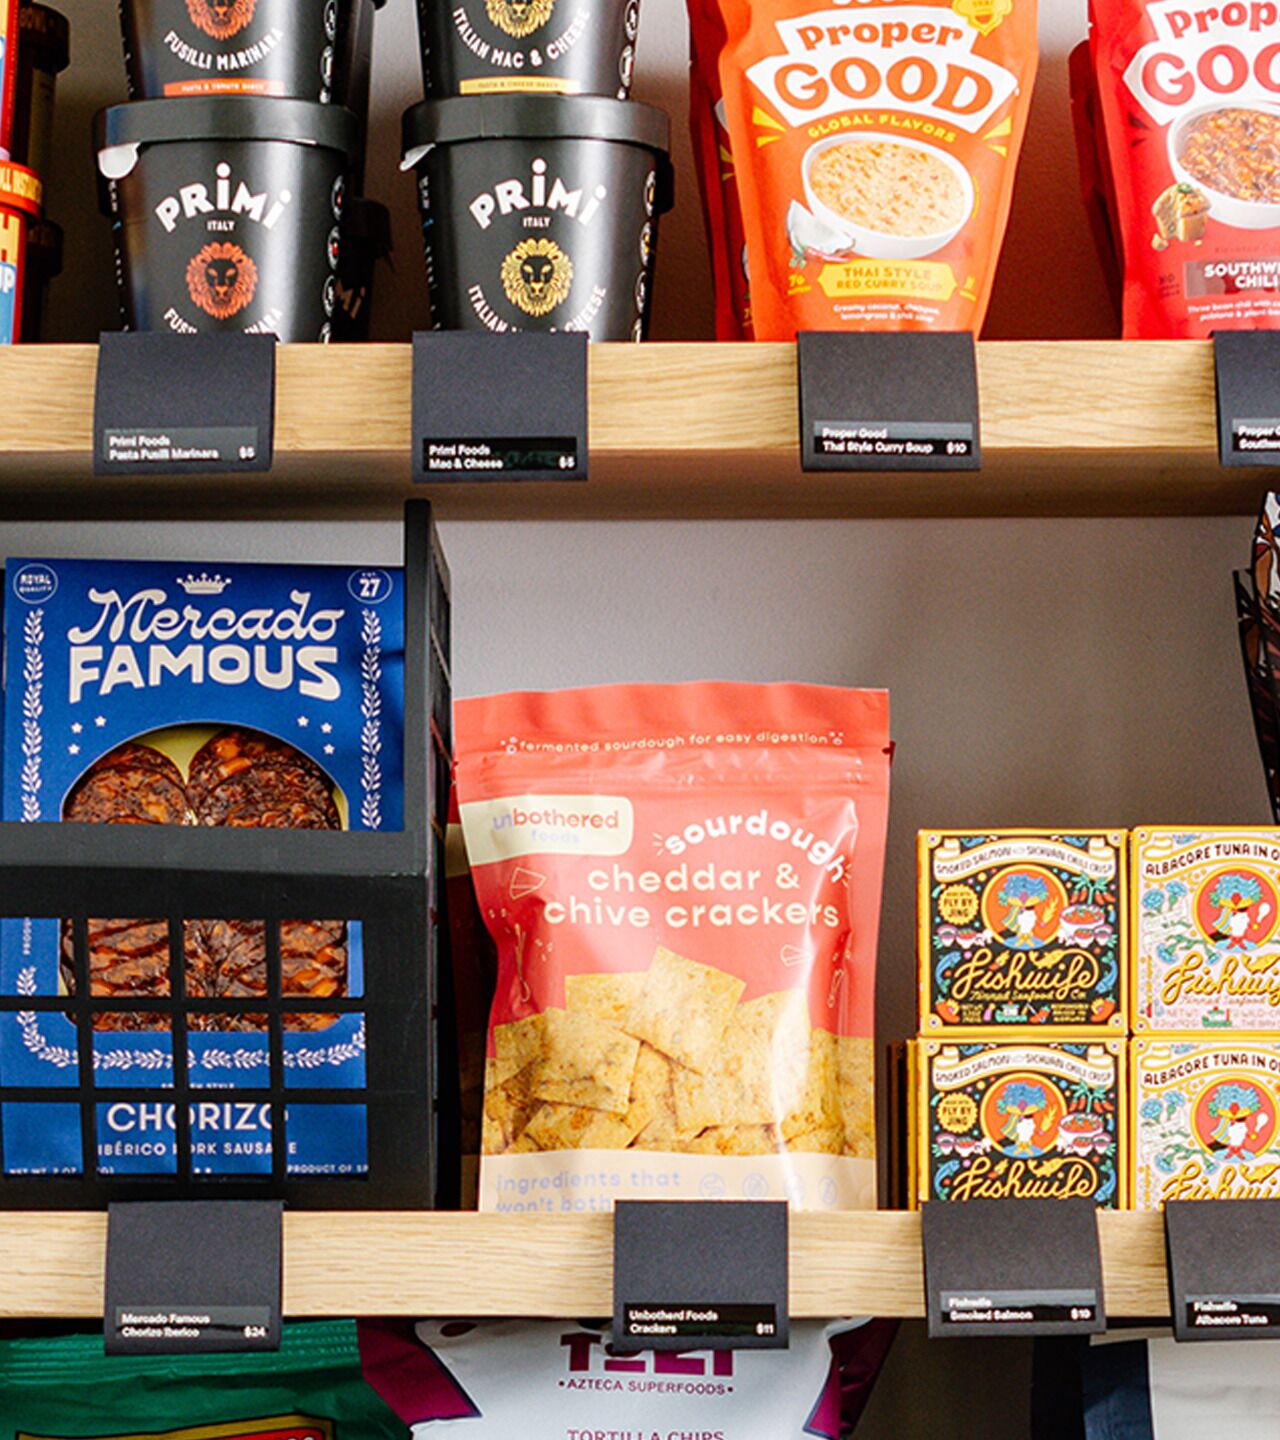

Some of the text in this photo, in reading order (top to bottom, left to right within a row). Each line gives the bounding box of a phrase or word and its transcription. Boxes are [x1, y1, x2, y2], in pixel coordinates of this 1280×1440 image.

[452, 7, 590, 69] ITALIAN MAC & CHEESE
[774, 56, 993, 115] GOOD
[1235, 274, 1277, 288] CHILI
[67, 589, 344, 643] Mercado
[70, 645, 341, 704] FAMOUS
[520, 732, 827, 752] fermented sourdough for easy digestion
[664, 809, 845, 882] sourdough
[1146, 845, 1210, 875] ALBACORE
[1214, 844, 1249, 858] TUNA
[1254, 846, 1266, 858] IN
[588, 864, 799, 891] cheddar &
[544, 896, 839, 928] chive crackers
[567, 1379, 725, 1396] AZTECA SUPERFOODS
